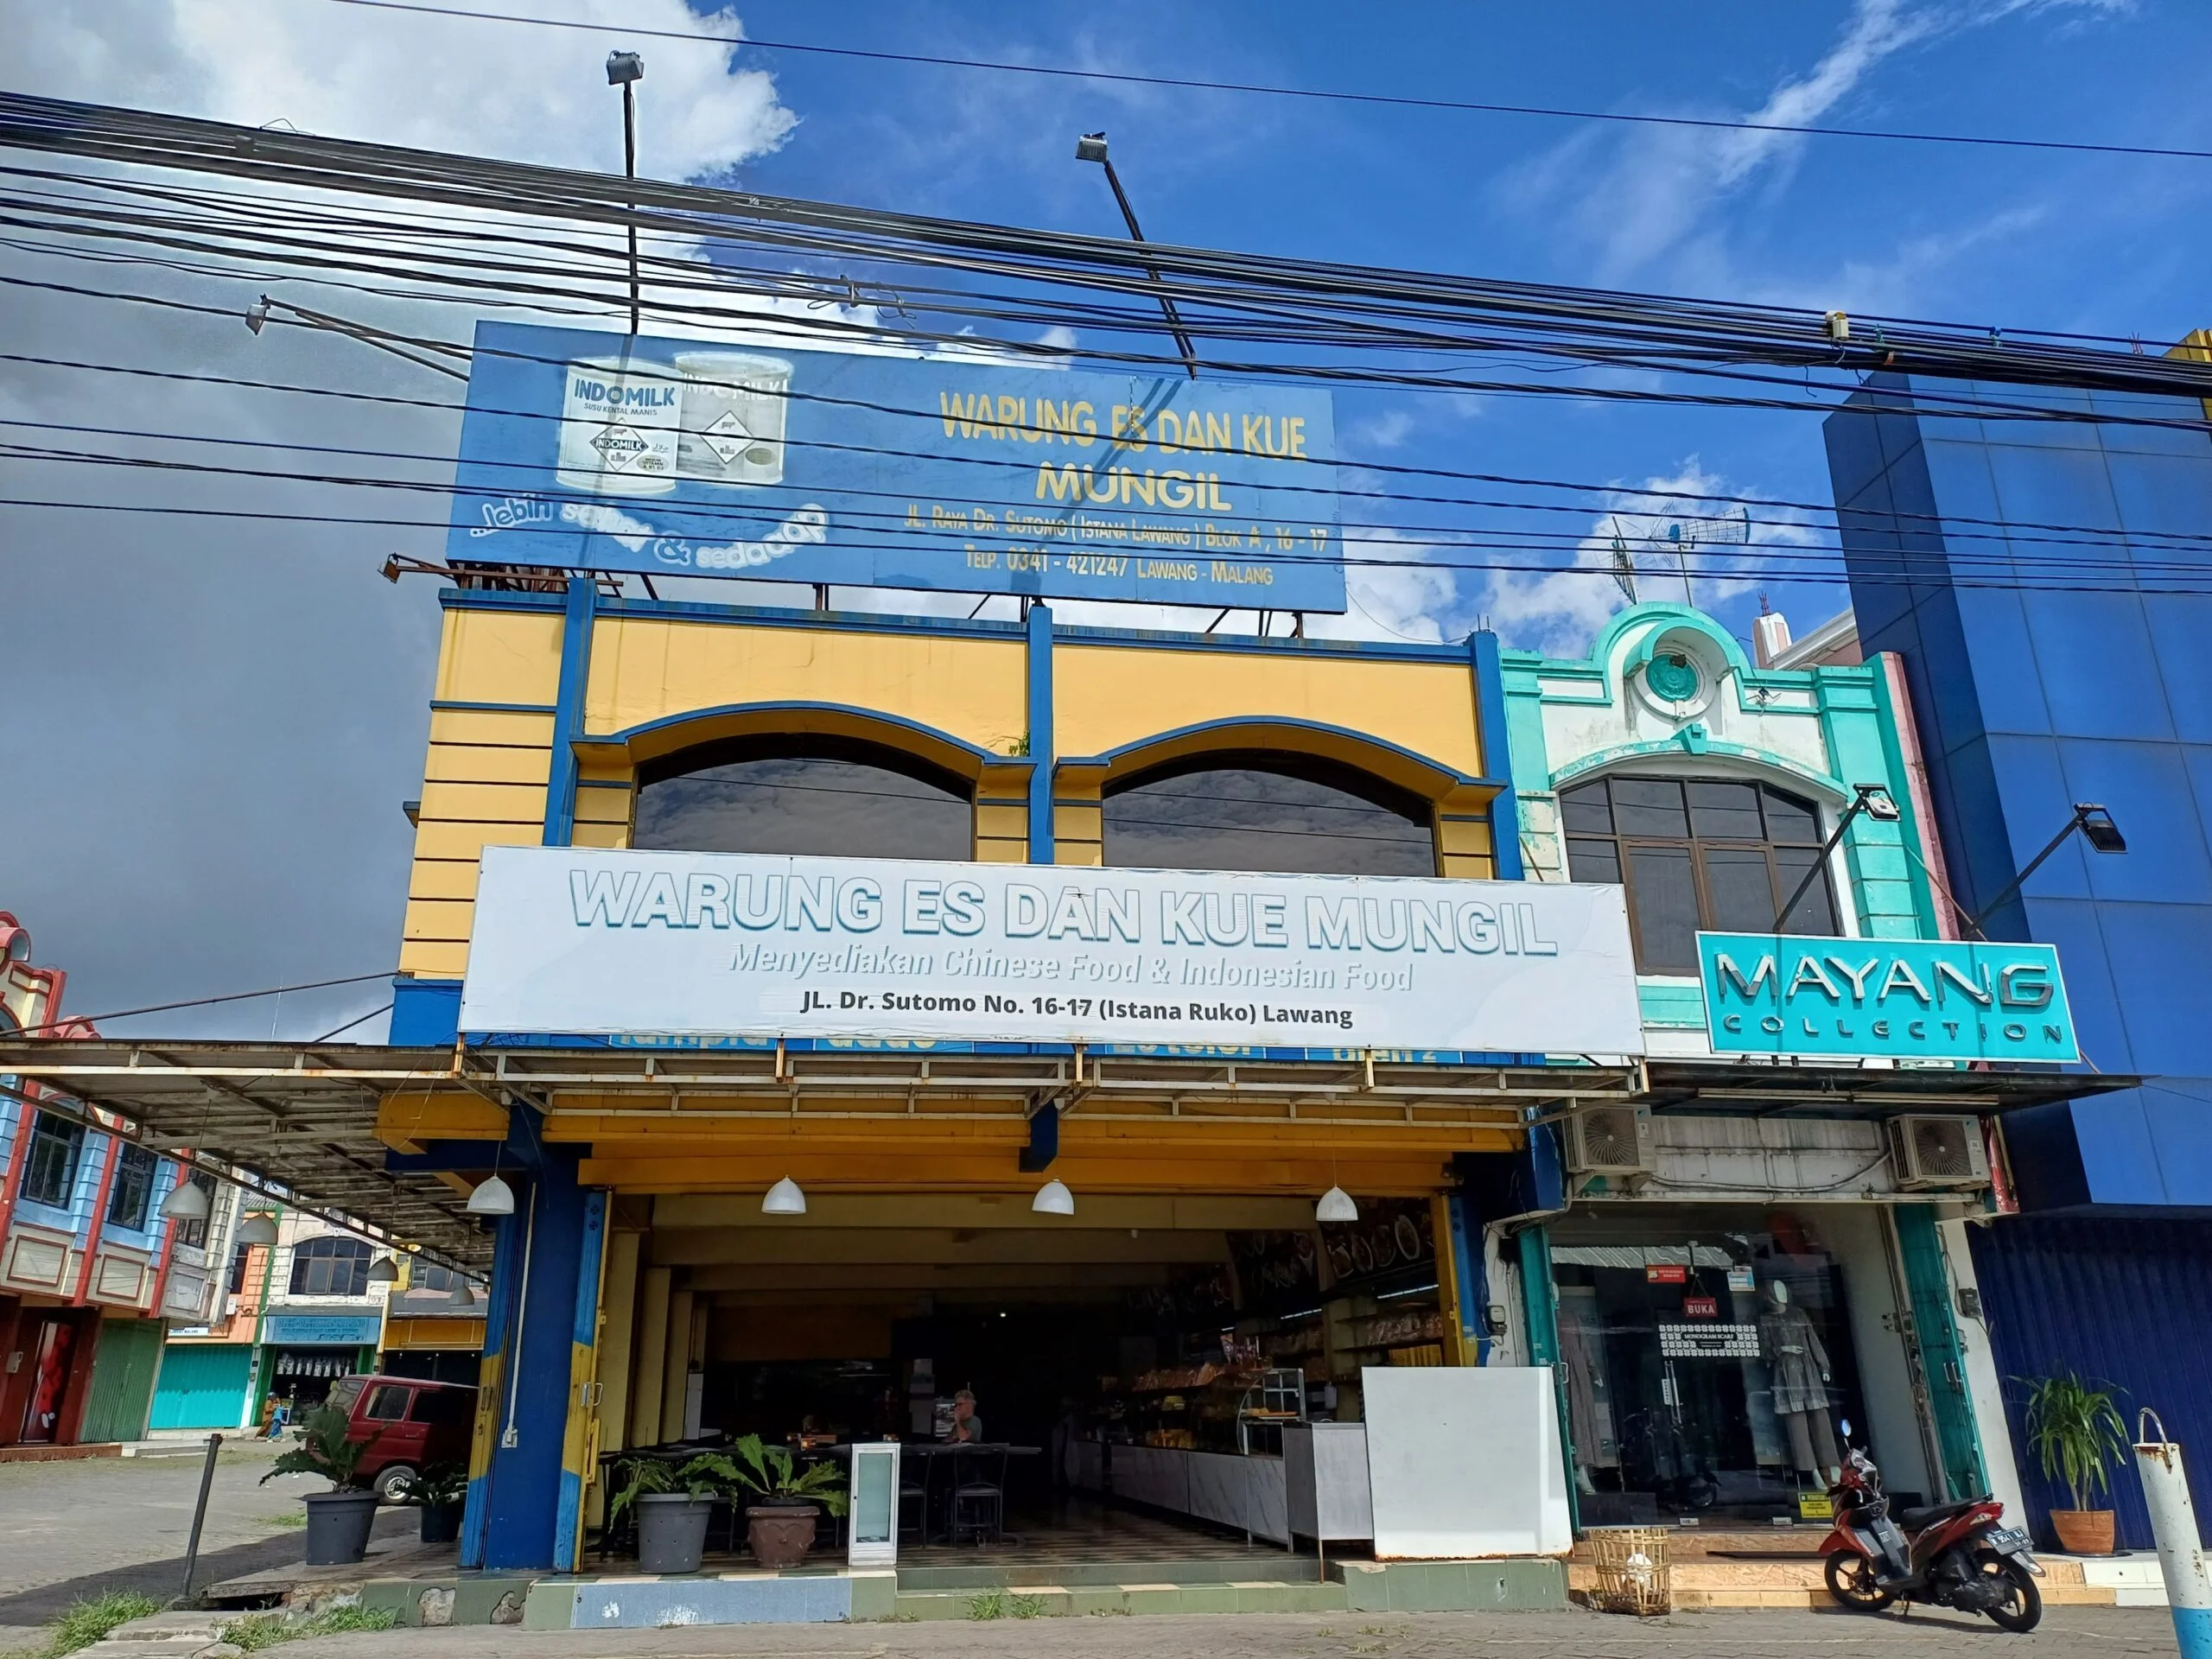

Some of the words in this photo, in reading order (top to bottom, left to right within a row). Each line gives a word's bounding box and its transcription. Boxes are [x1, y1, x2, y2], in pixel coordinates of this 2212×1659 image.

[574, 378, 675, 407] INDOMILK
[584, 403, 602, 412] SUSU
[603, 406, 629, 416] KENTAL
[940, 391, 1097, 448] WARUNG
[1111, 405, 1147, 452] ES
[1157, 410, 1231, 457] DAN
[1243, 414, 1307, 462] KUE
[595, 439, 643, 451] INDOMILK
[1035, 461, 1232, 511] MUNGIL
[905, 504, 926, 528] JL.
[657, 531, 689, 563] &
[1006, 545, 1048, 572] 0341
[1066, 550, 1129, 577] 421247
[1137, 558, 1198, 582] LAWANG
[1211, 560, 1274, 586] MALANG
[569, 869, 882, 933] WARUNG
[902, 878, 986, 938] ES
[1005, 883, 1141, 944] DAN
[1160, 890, 1289, 948] KUE
[1305, 895, 1558, 957] MUNGIL
[728, 943, 933, 981] Menyediakan
[942, 946, 1061, 981] Chinese
[1069, 954, 1142, 983] Food
[1150, 956, 1171, 985] &
[1179, 956, 1335, 989] Indonesian
[1344, 963, 1414, 991] Food
[1715, 952, 2054, 1007] MAYANG
[799, 991, 831, 1014] JL.
[839, 991, 875, 1011] Dr.
[881, 992, 976, 1013] Sutomo
[984, 995, 1024, 1014] No.
[1032, 996, 1093, 1018] 16-17
[1099, 999, 1182, 1020] (Istana
[1189, 1002, 1257, 1026] Ruko)
[1263, 1005, 1353, 1029] Lawang
[1724, 1014, 2064, 1045] COLLECTION
[1687, 1304, 1715, 1314] BUKA
